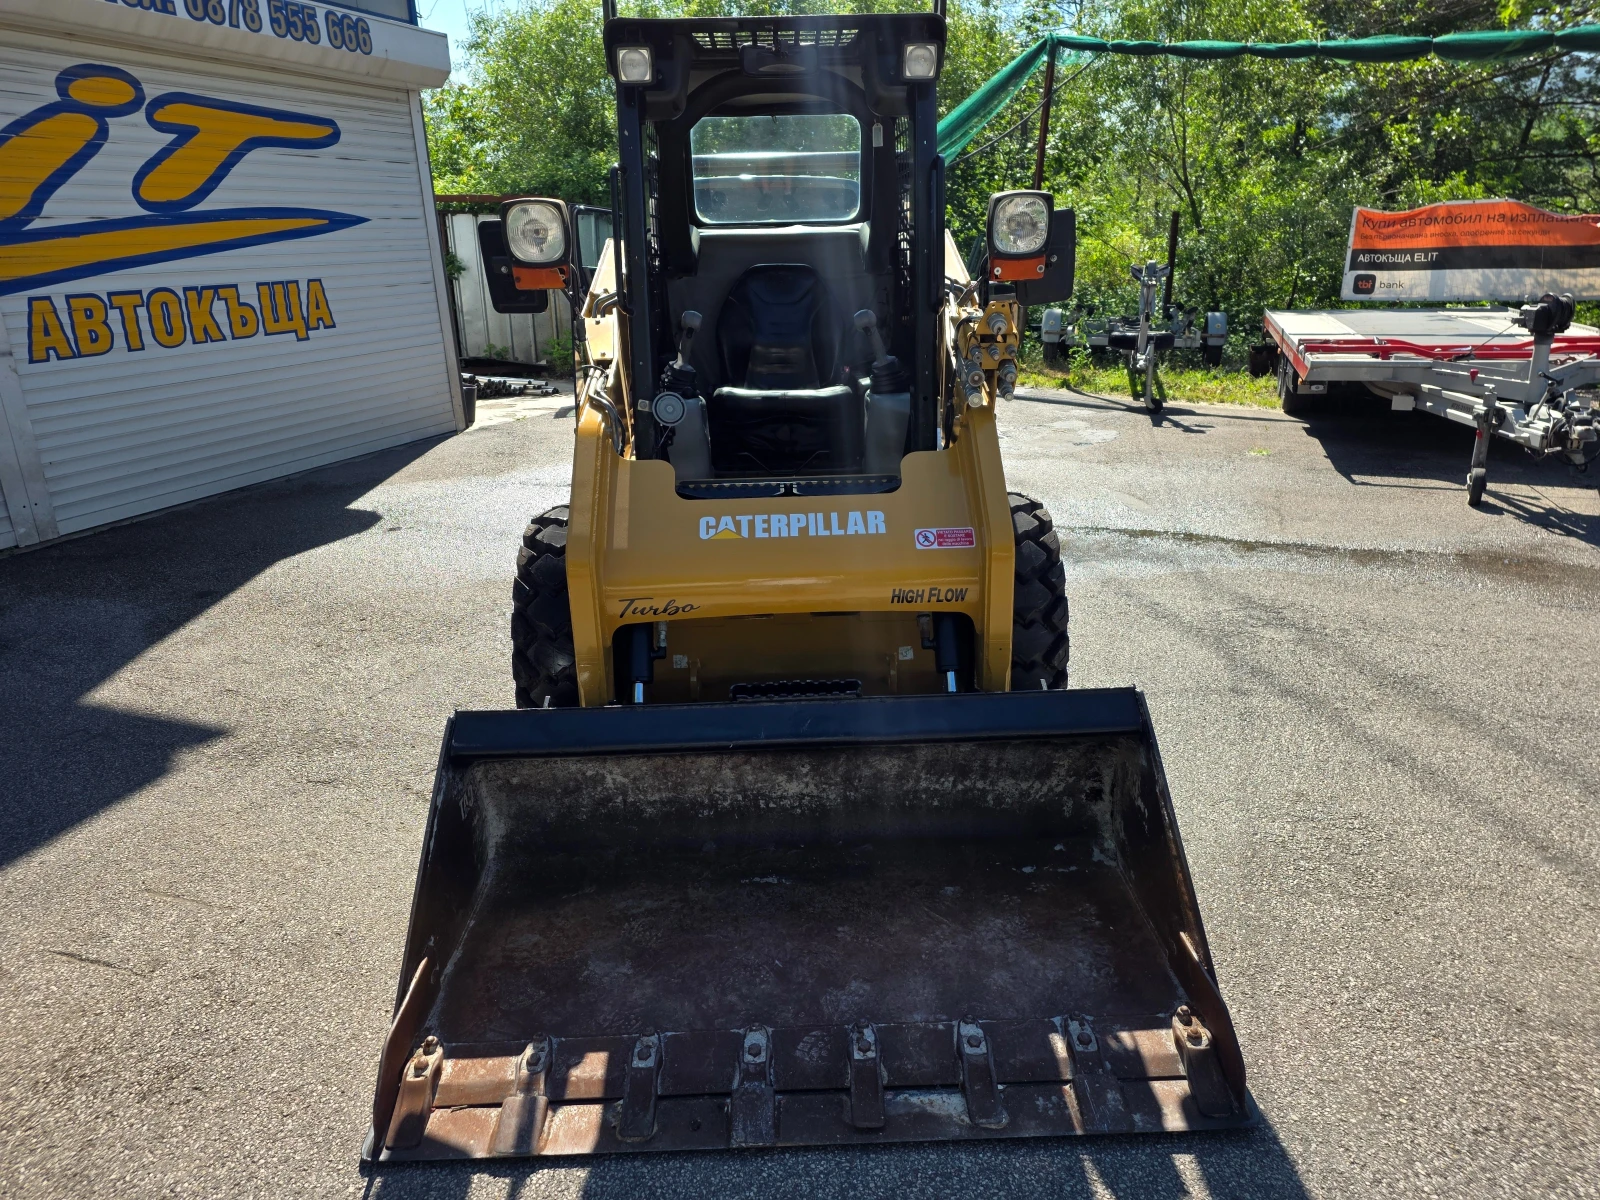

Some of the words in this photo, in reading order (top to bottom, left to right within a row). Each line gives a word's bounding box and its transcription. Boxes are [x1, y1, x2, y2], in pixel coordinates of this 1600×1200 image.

[268, 0, 321, 44] 555
[325, 10, 372, 55] 666
[1362, 217, 1396, 230] Купи
[1400, 212, 1482, 228] автомобил
[1486, 212, 1506, 223] на
[1357, 253, 1412, 264] АВТОКЪЩА
[1414, 252, 1439, 262] ELIT
[1358, 280, 1373, 289] tbi
[1379, 280, 1405, 289] bank
[28, 278, 336, 364] АВТОКЪЩА
[699, 510, 887, 540] CATERPILLAR
[890, 588, 925, 604] HIGH
[927, 587, 969, 603] FLOW
[618, 597, 701, 619] Turbo
